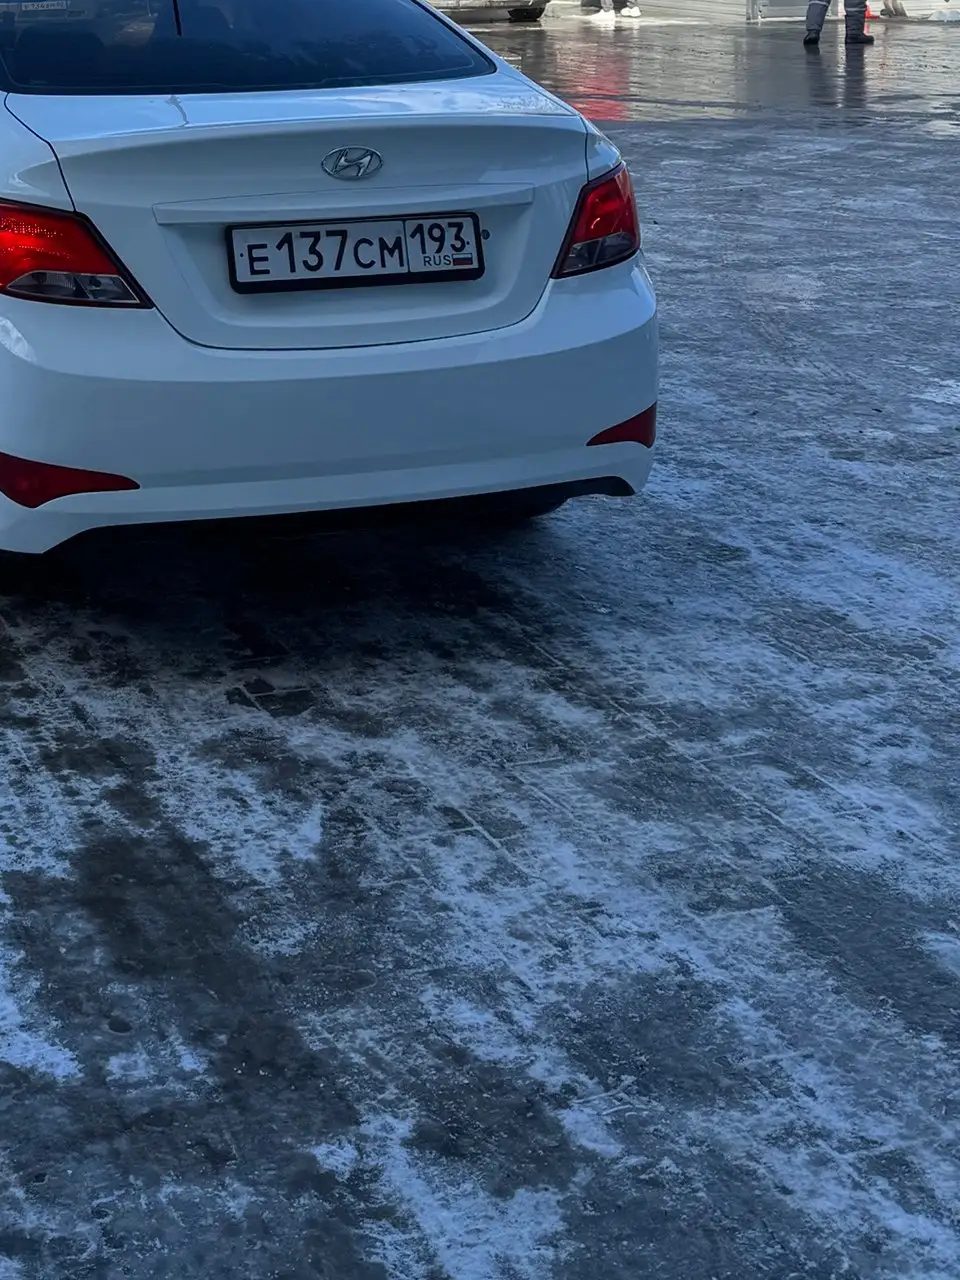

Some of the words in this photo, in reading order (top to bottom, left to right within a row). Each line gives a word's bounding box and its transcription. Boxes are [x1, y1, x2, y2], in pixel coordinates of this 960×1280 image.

[247, 229, 405, 276] Е137СМ
[409, 222, 467, 255] 193
[423, 253, 452, 267] RUS
